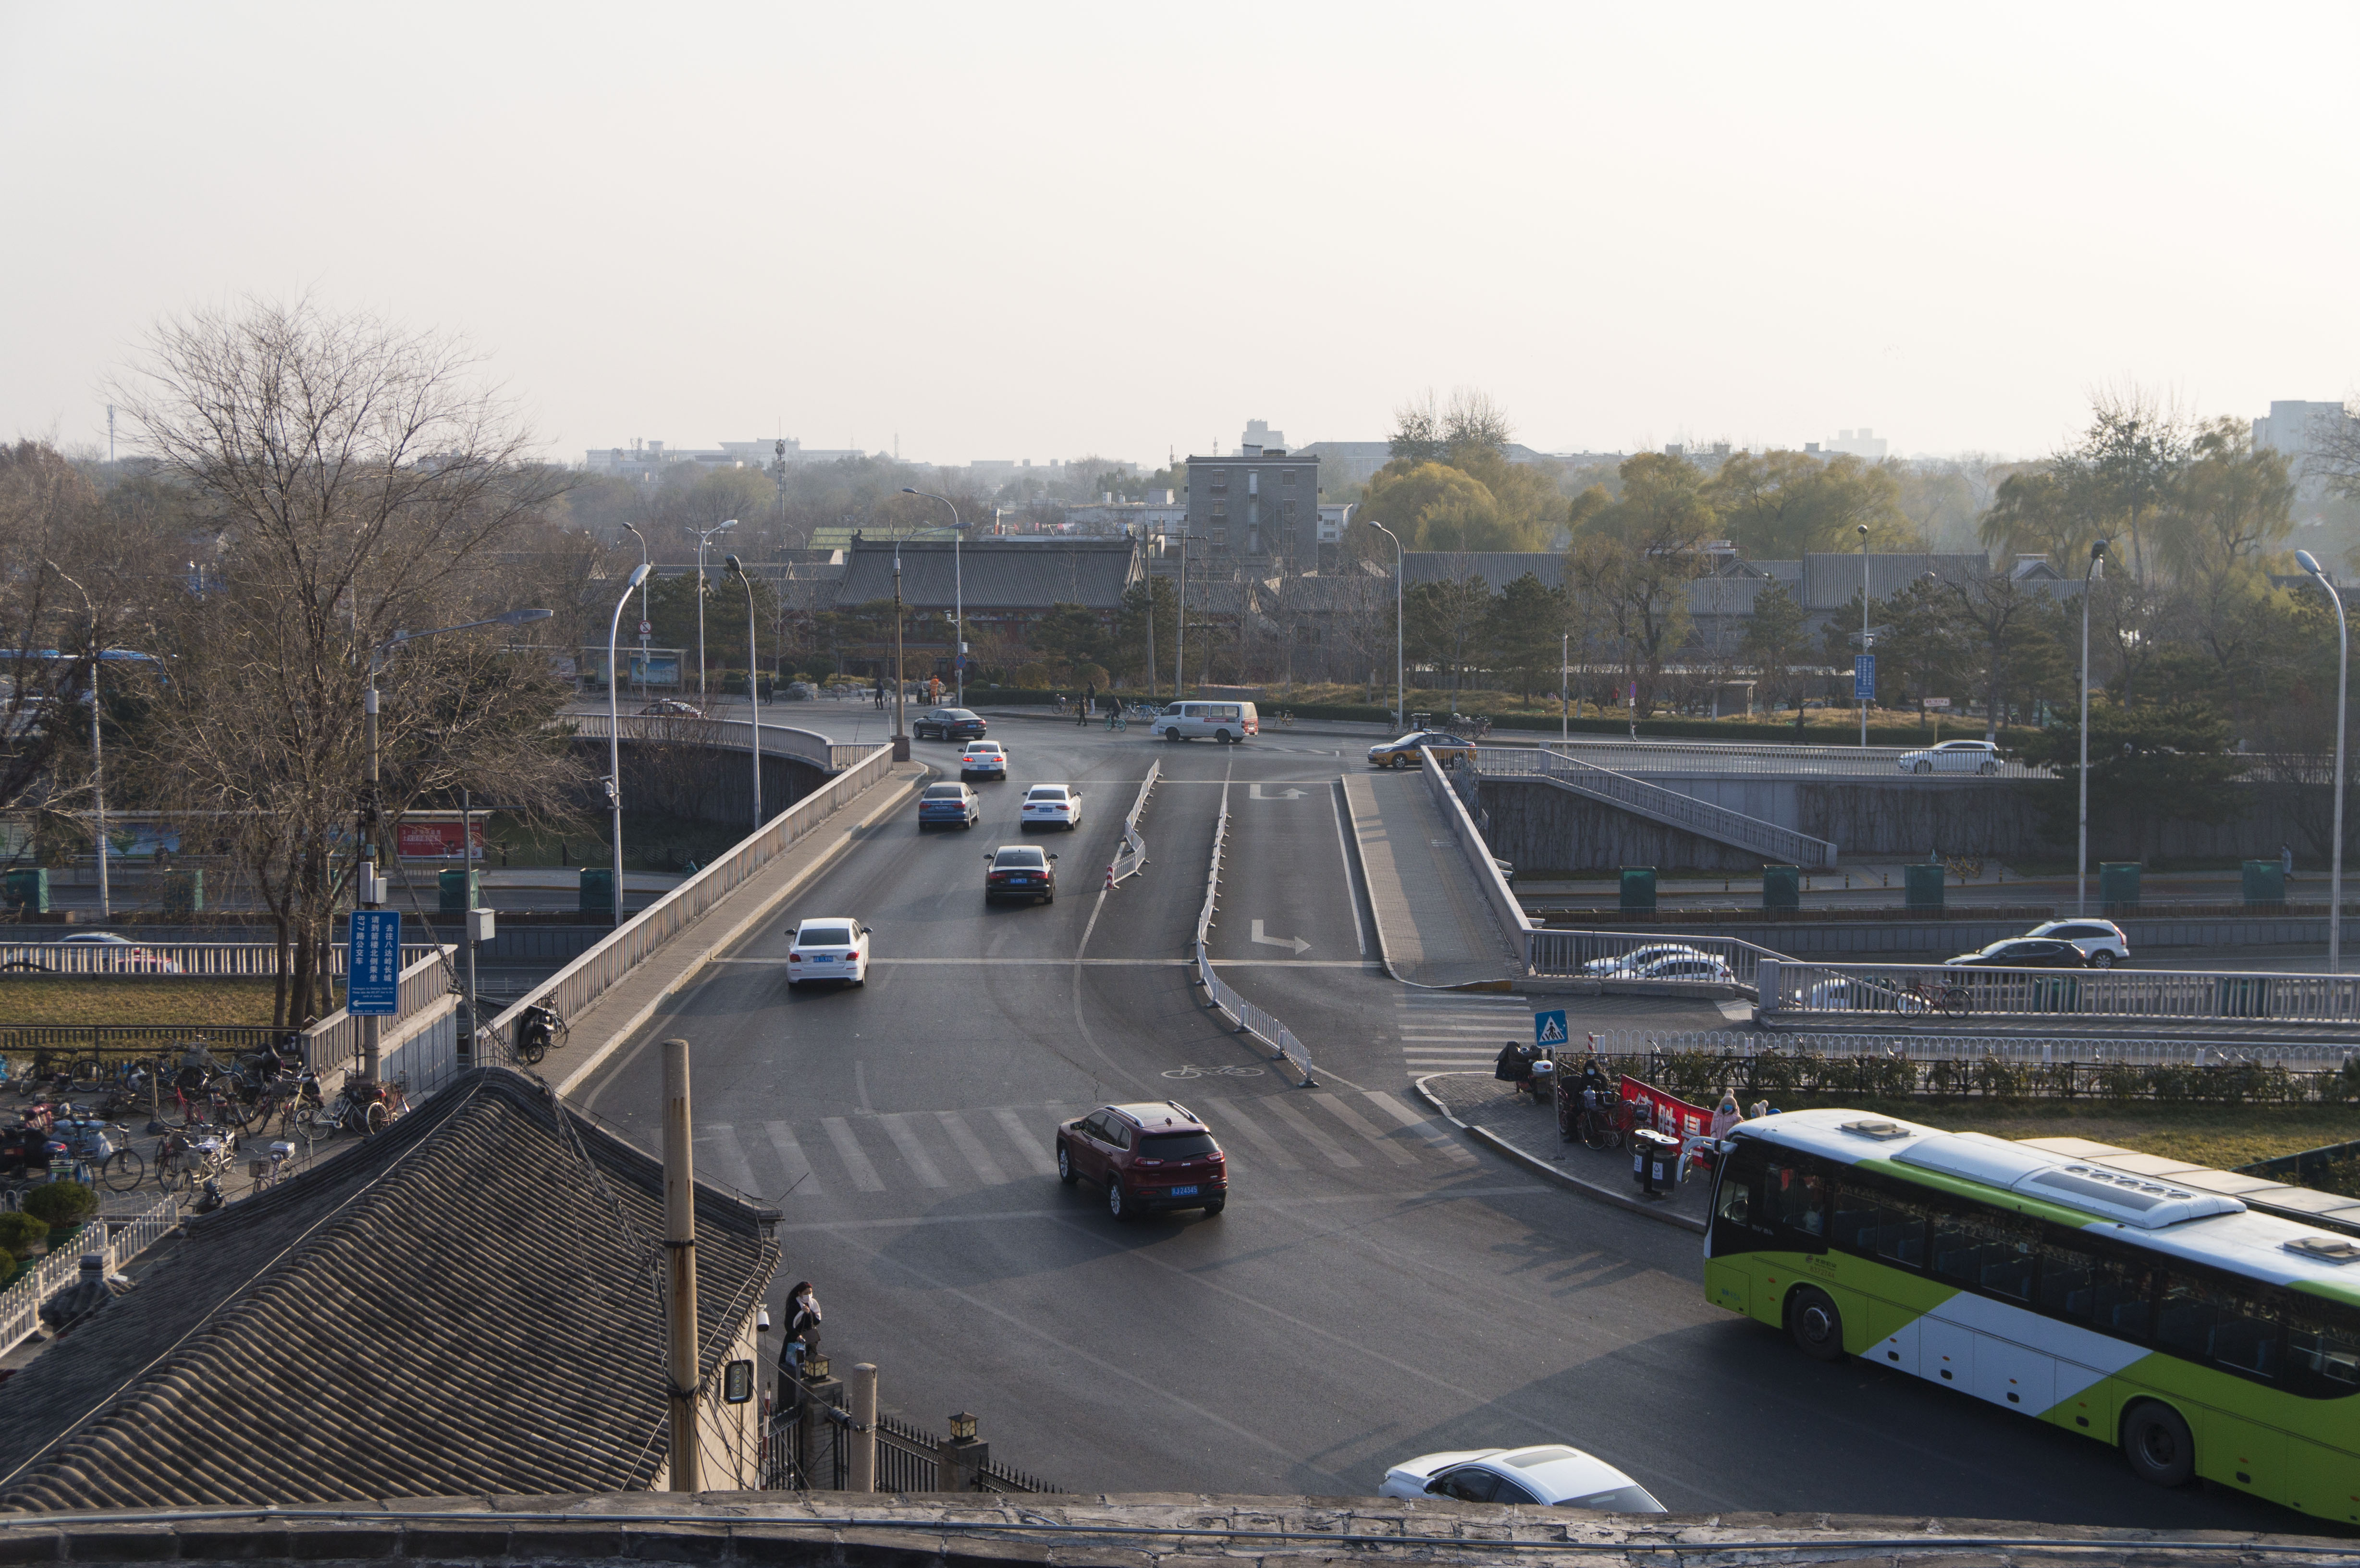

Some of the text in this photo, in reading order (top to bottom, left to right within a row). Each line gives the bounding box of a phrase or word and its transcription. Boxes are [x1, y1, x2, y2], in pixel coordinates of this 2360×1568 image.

[355, 915, 365, 965] 877路公交车
[369, 916, 380, 982] 请到箭楼北侧乘坐
[383, 924, 394, 982] 去往八达岭长城
